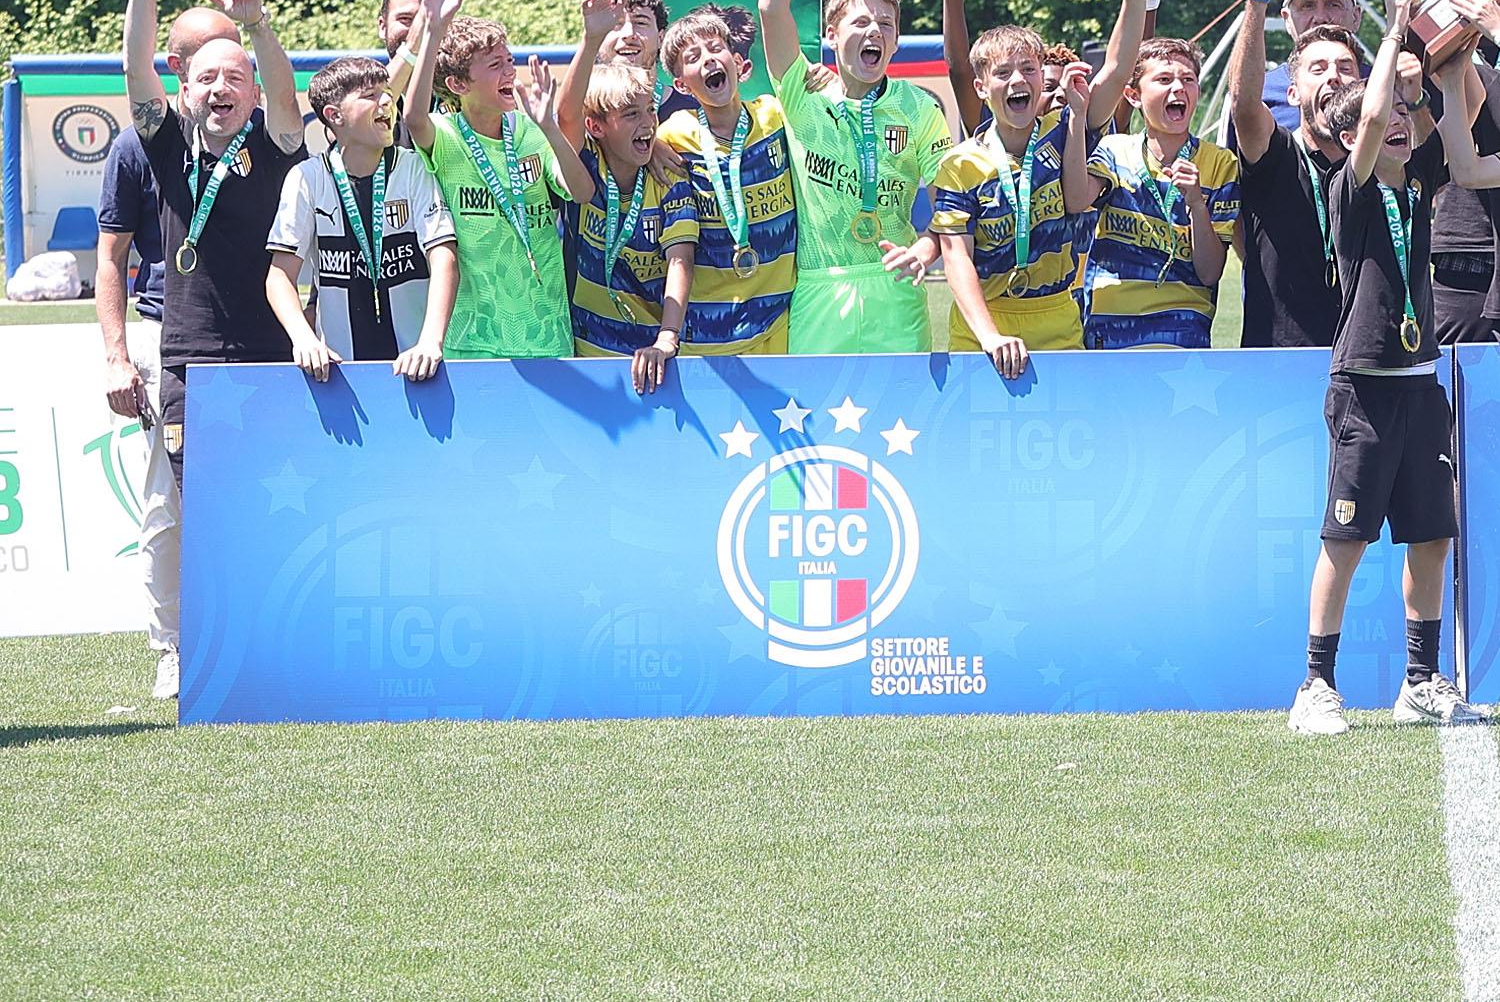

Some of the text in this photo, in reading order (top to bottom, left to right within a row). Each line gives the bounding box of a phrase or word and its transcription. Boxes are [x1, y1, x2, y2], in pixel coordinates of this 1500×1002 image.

[225, 133, 246, 160] 2026
[503, 126, 513, 163] FINALE
[509, 166, 523, 196] 2026
[465, 134, 507, 204] FINALE 2026
[337, 176, 358, 219] FINALE
[372, 200, 383, 232] 2026
[624, 200, 641, 232] 2026
[1388, 213, 1404, 248] 2026
[969, 418, 1096, 472] FIGC
[768, 514, 869, 558] FIGC
[798, 561, 837, 575] ITALIA
[334, 605, 486, 671] FIGC
[870, 636, 949, 657] SETTORE
[613, 647, 684, 680] FIGC
[870, 655, 984, 676] GIOVANILE E
[378, 678, 437, 698] ITALIA
[870, 674, 987, 695] SCOLASTICO
